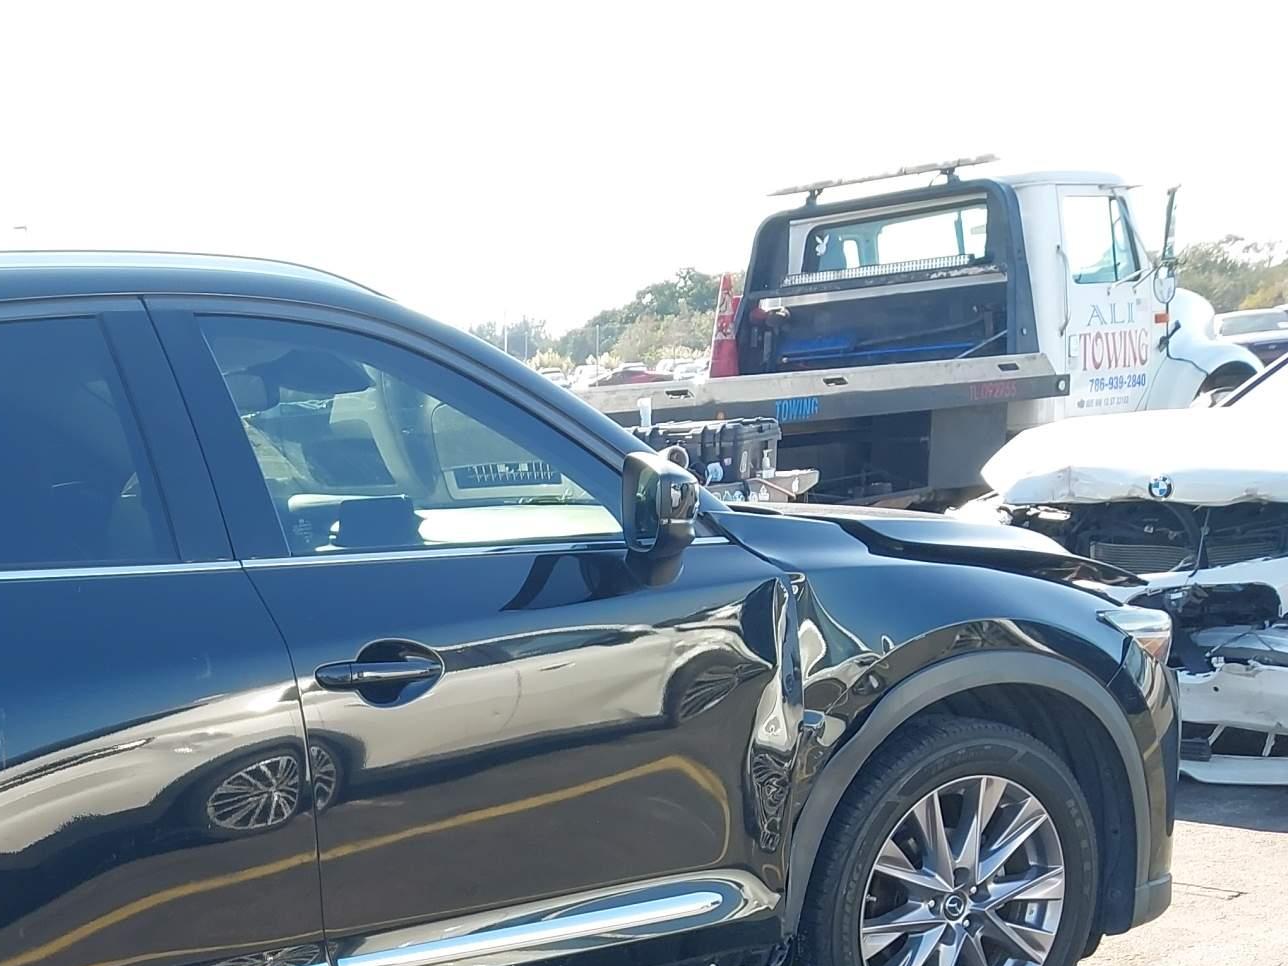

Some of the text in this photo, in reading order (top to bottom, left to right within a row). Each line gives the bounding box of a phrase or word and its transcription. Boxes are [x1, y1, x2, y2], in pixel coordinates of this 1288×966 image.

[1086, 302, 1135, 327] ALI
[1078, 328, 1149, 372] TOWING
[1088, 373, 1146, 392] 786-939-2840
[775, 397, 818, 421] TOWING
